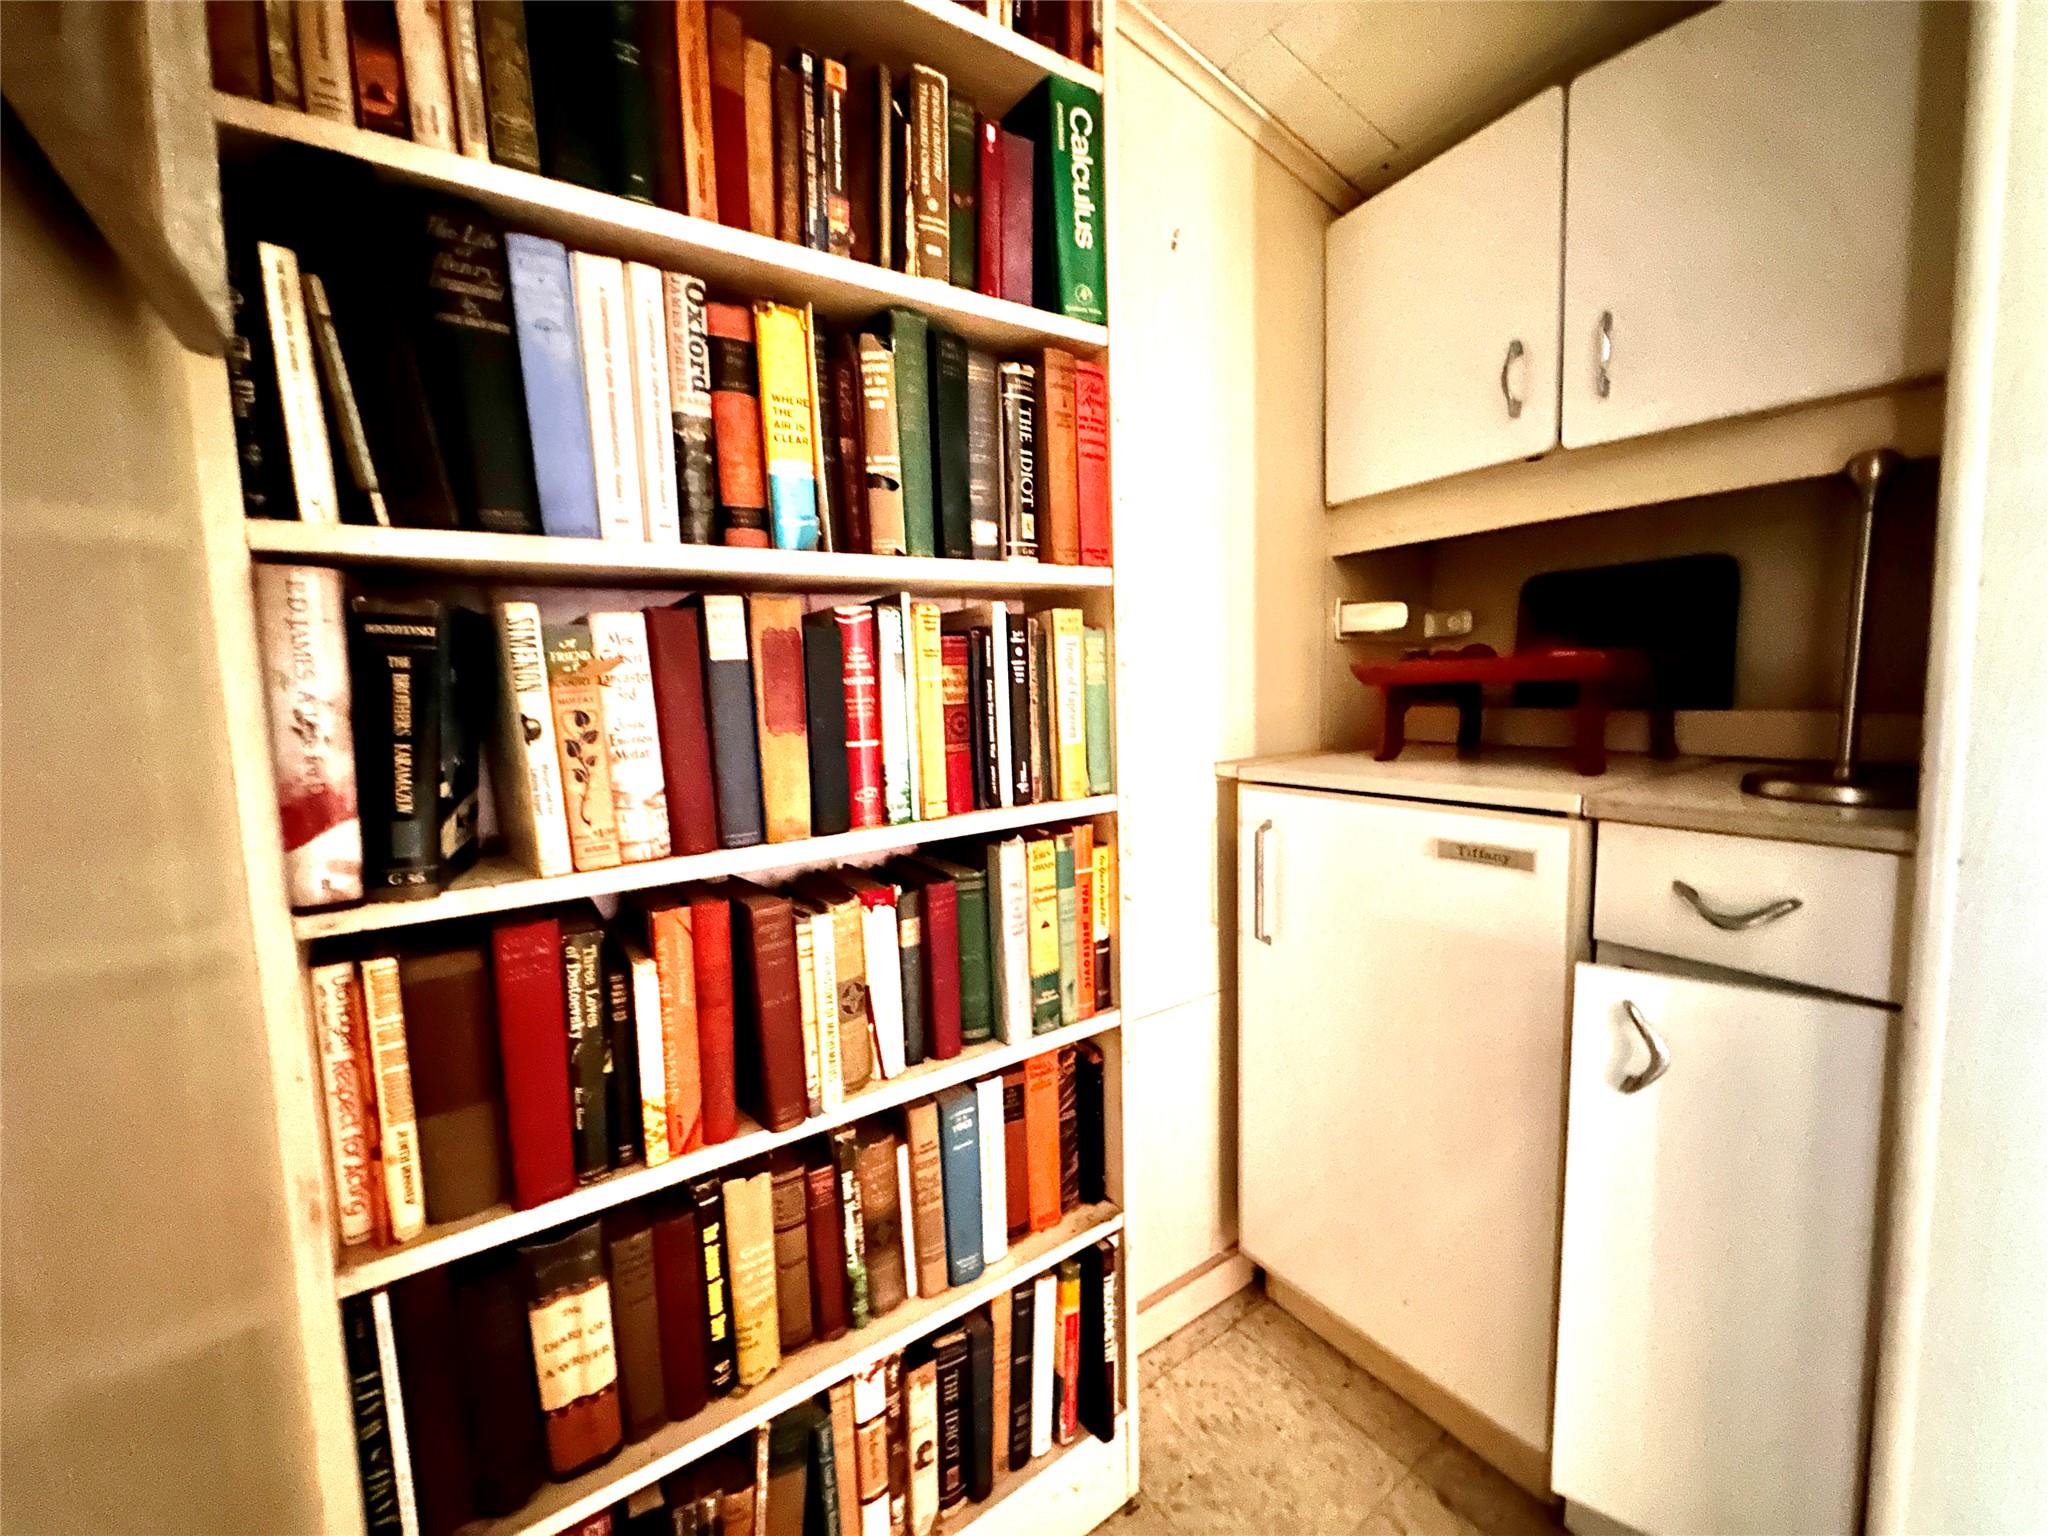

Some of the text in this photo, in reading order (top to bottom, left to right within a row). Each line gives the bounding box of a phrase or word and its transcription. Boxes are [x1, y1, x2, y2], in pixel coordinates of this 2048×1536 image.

[1070, 106, 1095, 250] Calculus
[670, 277, 684, 328] JAMES
[685, 280, 710, 393] Oxford
[771, 393, 810, 409] WHERE
[772, 406, 793, 418] THE
[773, 420, 806, 433] AIR IS
[1018, 407, 1033, 442] THE
[773, 434, 809, 445] CLEAR
[1019, 448, 1035, 508] IDIOT
[506, 617, 542, 693] SIMENON
[391, 673, 412, 737] BROTHERS
[393, 743, 414, 815] KARAMAZOV
[1456, 843, 1511, 867] Tiffany
[1081, 884, 1090, 914] IVAN
[565, 945, 585, 1039] of Dostoevsky
[583, 944, 599, 1028] Three Loves
[558, 1344, 610, 1372] WRITER
[943, 1368, 960, 1461] THE IDIOT
